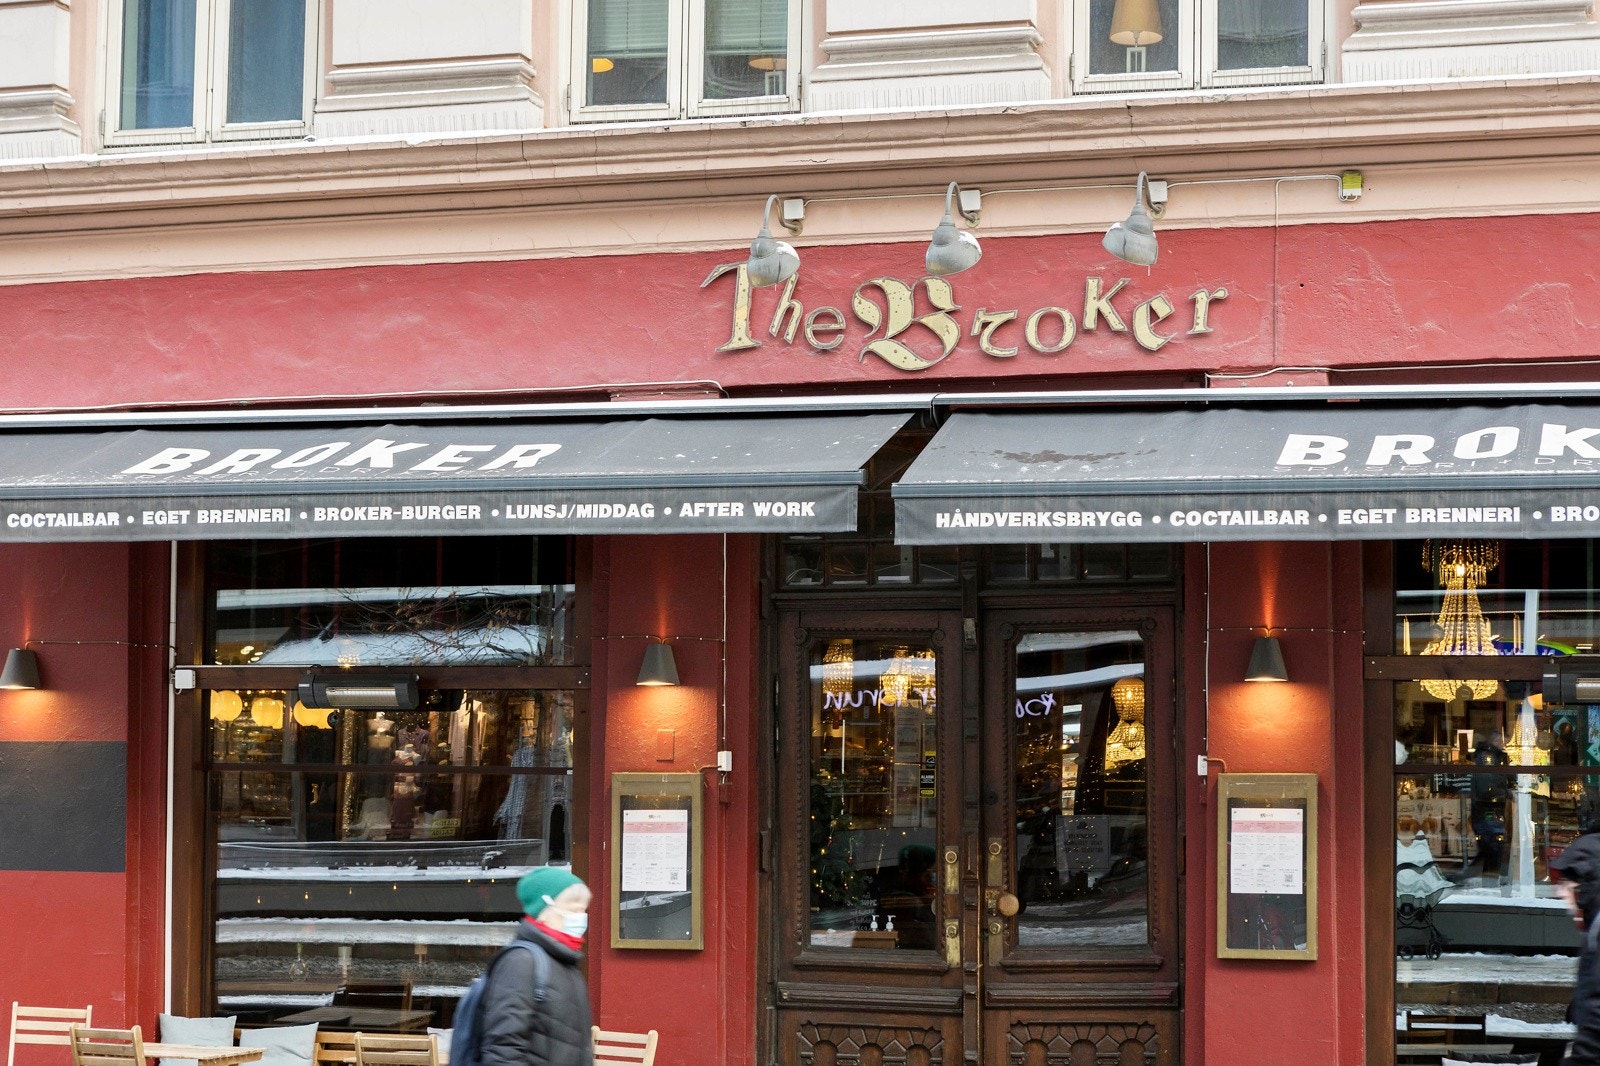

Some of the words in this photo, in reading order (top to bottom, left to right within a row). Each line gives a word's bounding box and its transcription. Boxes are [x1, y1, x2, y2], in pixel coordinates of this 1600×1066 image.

[700, 261, 846, 352] The
[851, 275, 1229, 371] Broker
[121, 438, 562, 475] BROKER
[1277, 424, 1600, 466] BROK
[7, 511, 119, 528] COCTAILBAR
[142, 510, 191, 525] EGET
[197, 508, 291, 524] BRENNERI
[313, 505, 481, 522] BROKER-BURGER
[505, 503, 655, 519] LUNSJ/MIDDAG
[678, 502, 745, 518] AFTER
[752, 502, 816, 517] WORK
[936, 509, 1142, 527] HÅNDVERKSBRYGG
[1170, 510, 1310, 526] COCTAILBAR
[1338, 509, 1397, 524] EGET
[1406, 507, 1520, 523] BRENNERI
[1551, 506, 1600, 522] BRO
